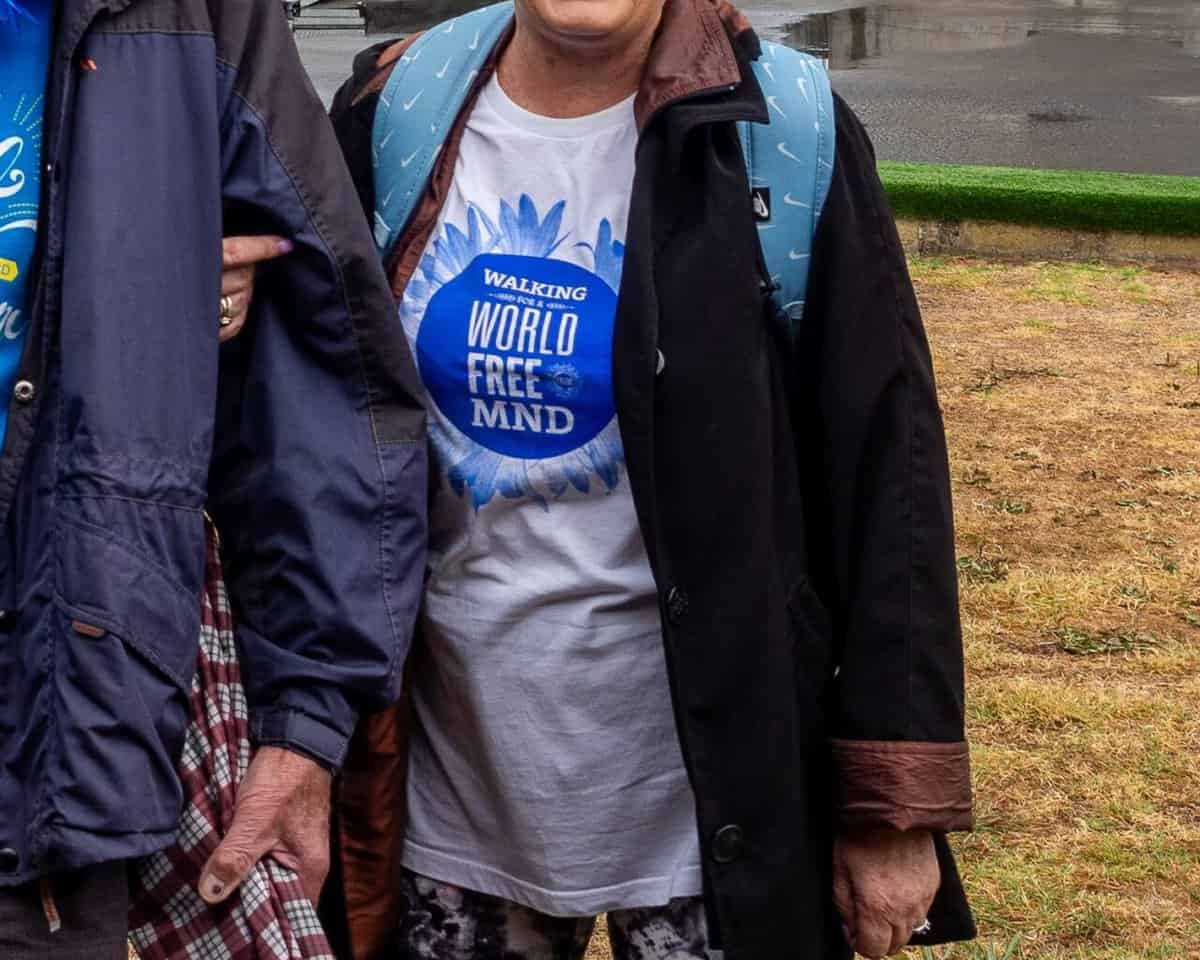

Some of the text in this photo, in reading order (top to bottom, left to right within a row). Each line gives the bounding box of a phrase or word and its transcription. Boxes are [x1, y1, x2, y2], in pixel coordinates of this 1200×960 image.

[484, 268, 588, 301] WALKING
[467, 300, 579, 356] WORLD
[467, 352, 544, 399] FREE
[471, 398, 575, 435] MND
